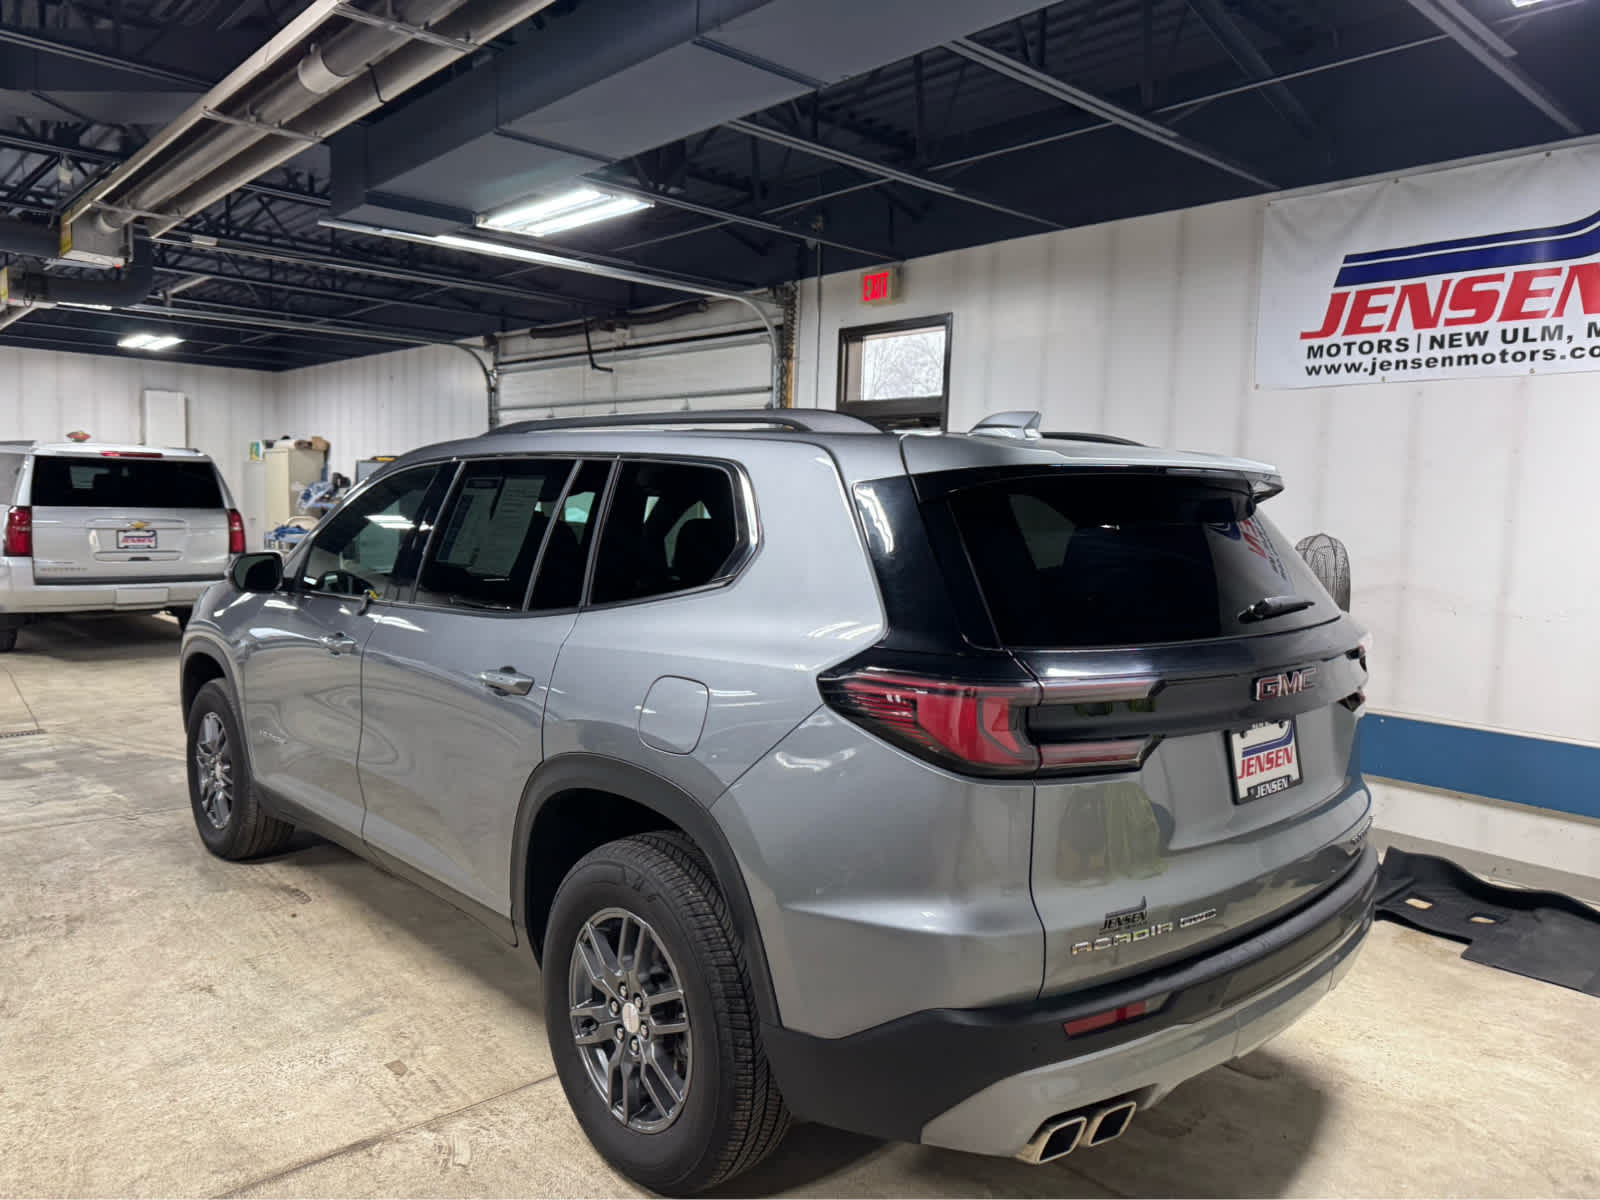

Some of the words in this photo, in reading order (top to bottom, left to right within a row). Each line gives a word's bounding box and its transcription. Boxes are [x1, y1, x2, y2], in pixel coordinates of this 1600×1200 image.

[863, 271, 889, 302] EXIT
[1300, 262, 1600, 340] JENSEN
[1306, 337, 1410, 360] MOTORS
[1429, 330, 1489, 350] NEW
[1500, 324, 1574, 345] ULM,
[1255, 665, 1318, 702] GMC
[1237, 744, 1294, 780] JENSEN
[1255, 776, 1289, 799] JENSEN
[1103, 910, 1148, 930] JENSEN
[1071, 921, 1174, 956] ACADIA
